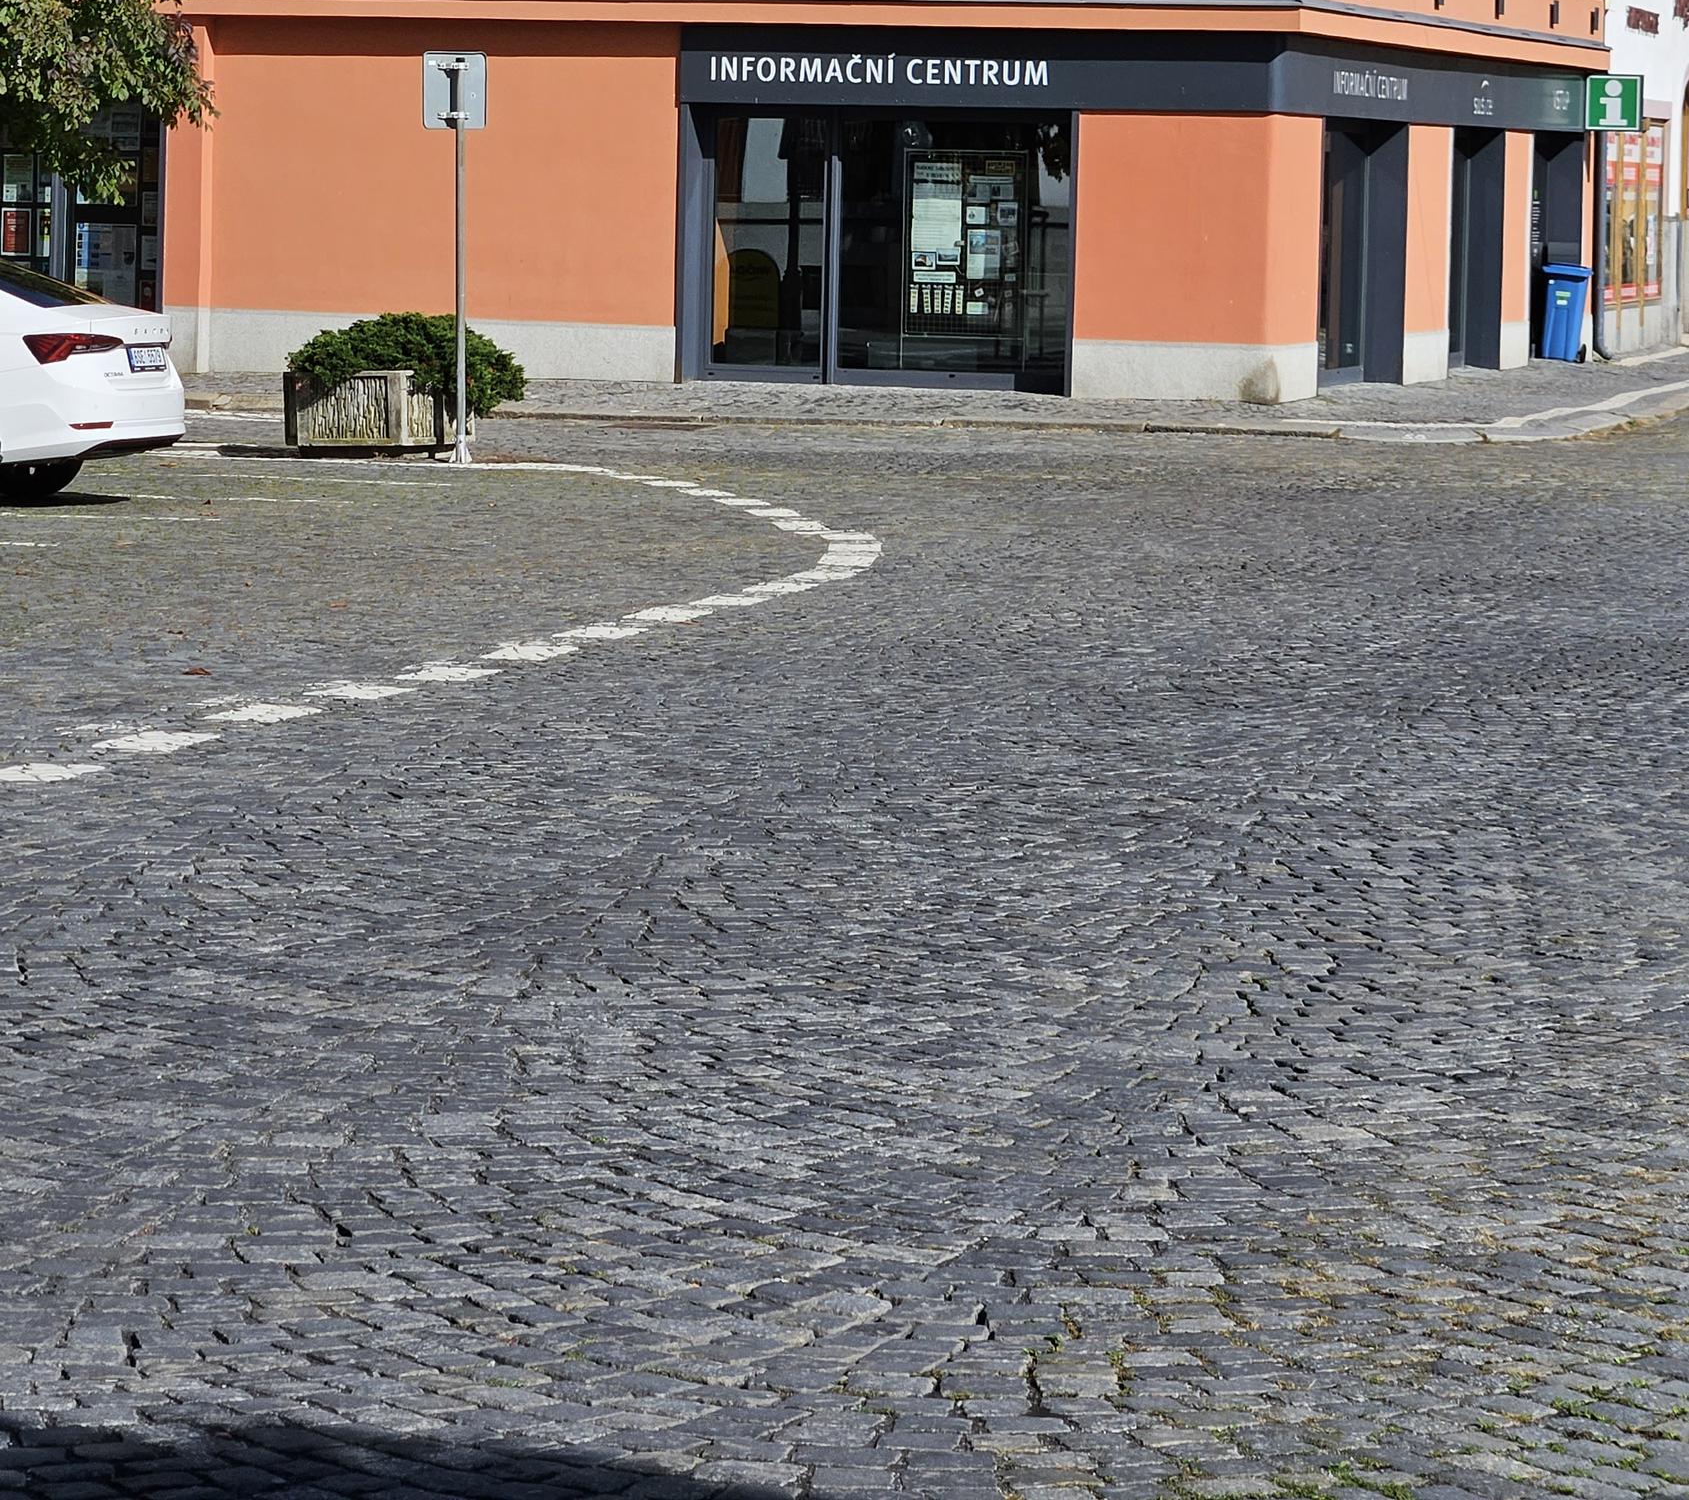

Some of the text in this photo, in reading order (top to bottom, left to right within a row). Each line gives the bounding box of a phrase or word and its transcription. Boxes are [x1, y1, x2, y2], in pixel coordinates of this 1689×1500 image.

[710, 53, 1049, 86] INFORMAČNÍ CENTRUM
[1333, 69, 1408, 100] INFORMAČNÍ CENTRUM
